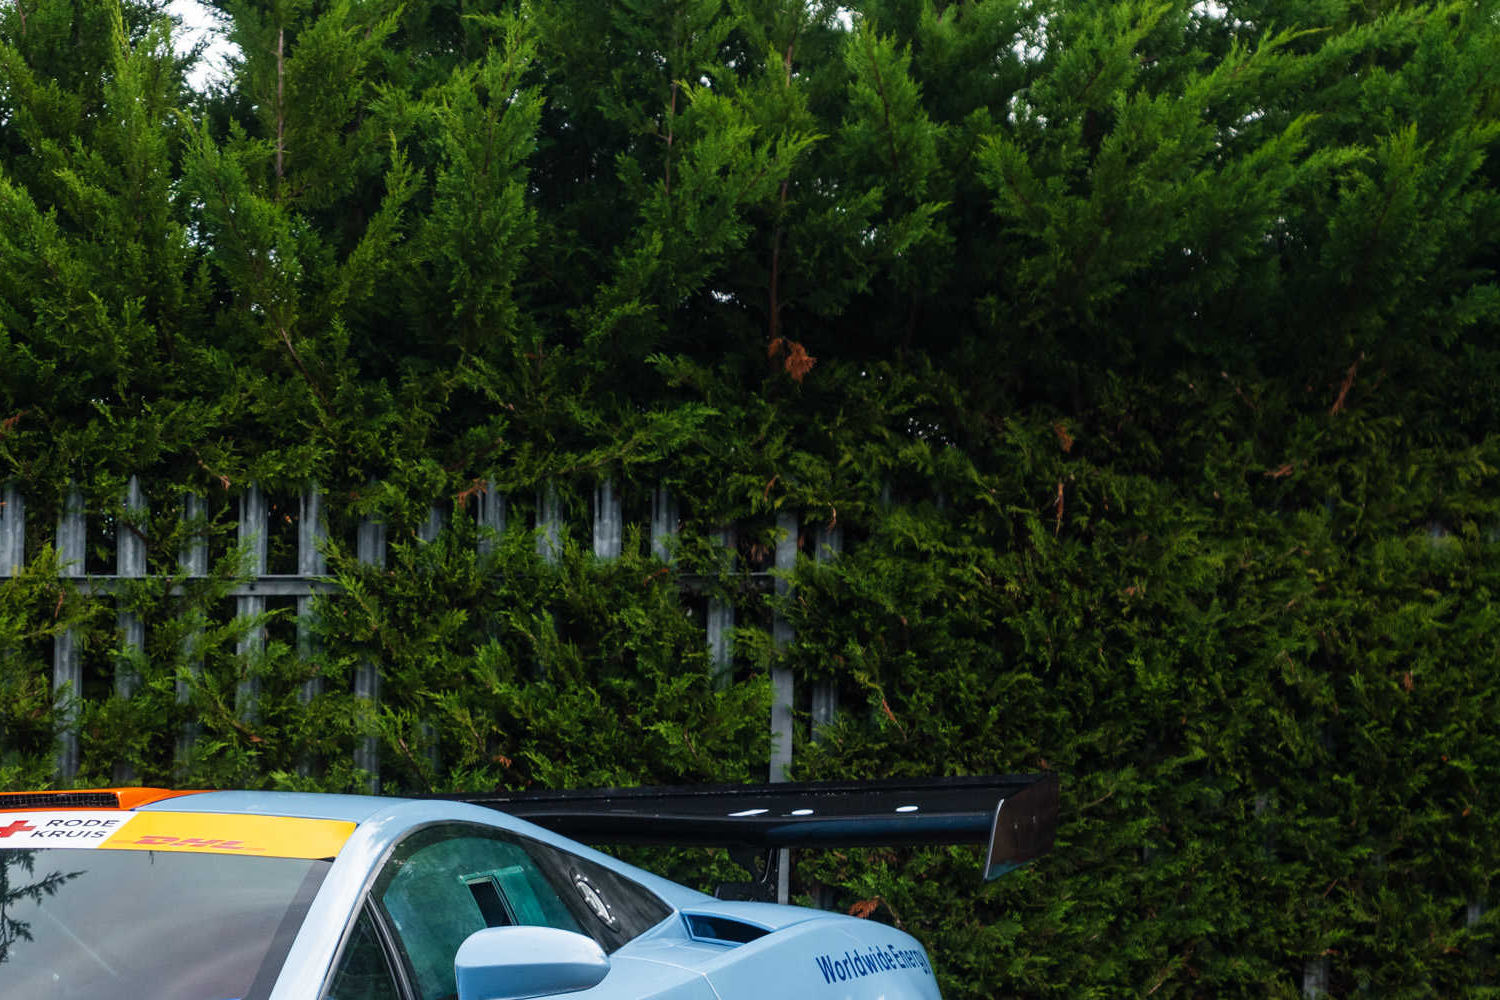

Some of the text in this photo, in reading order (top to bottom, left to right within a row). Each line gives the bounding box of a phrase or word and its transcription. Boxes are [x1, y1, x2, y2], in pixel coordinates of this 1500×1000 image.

[45, 819, 120, 828] RODE
[30, 830, 107, 839] KRUIS
[131, 835, 245, 850] DHL
[815, 944, 931, 984] Worldwide Energy
